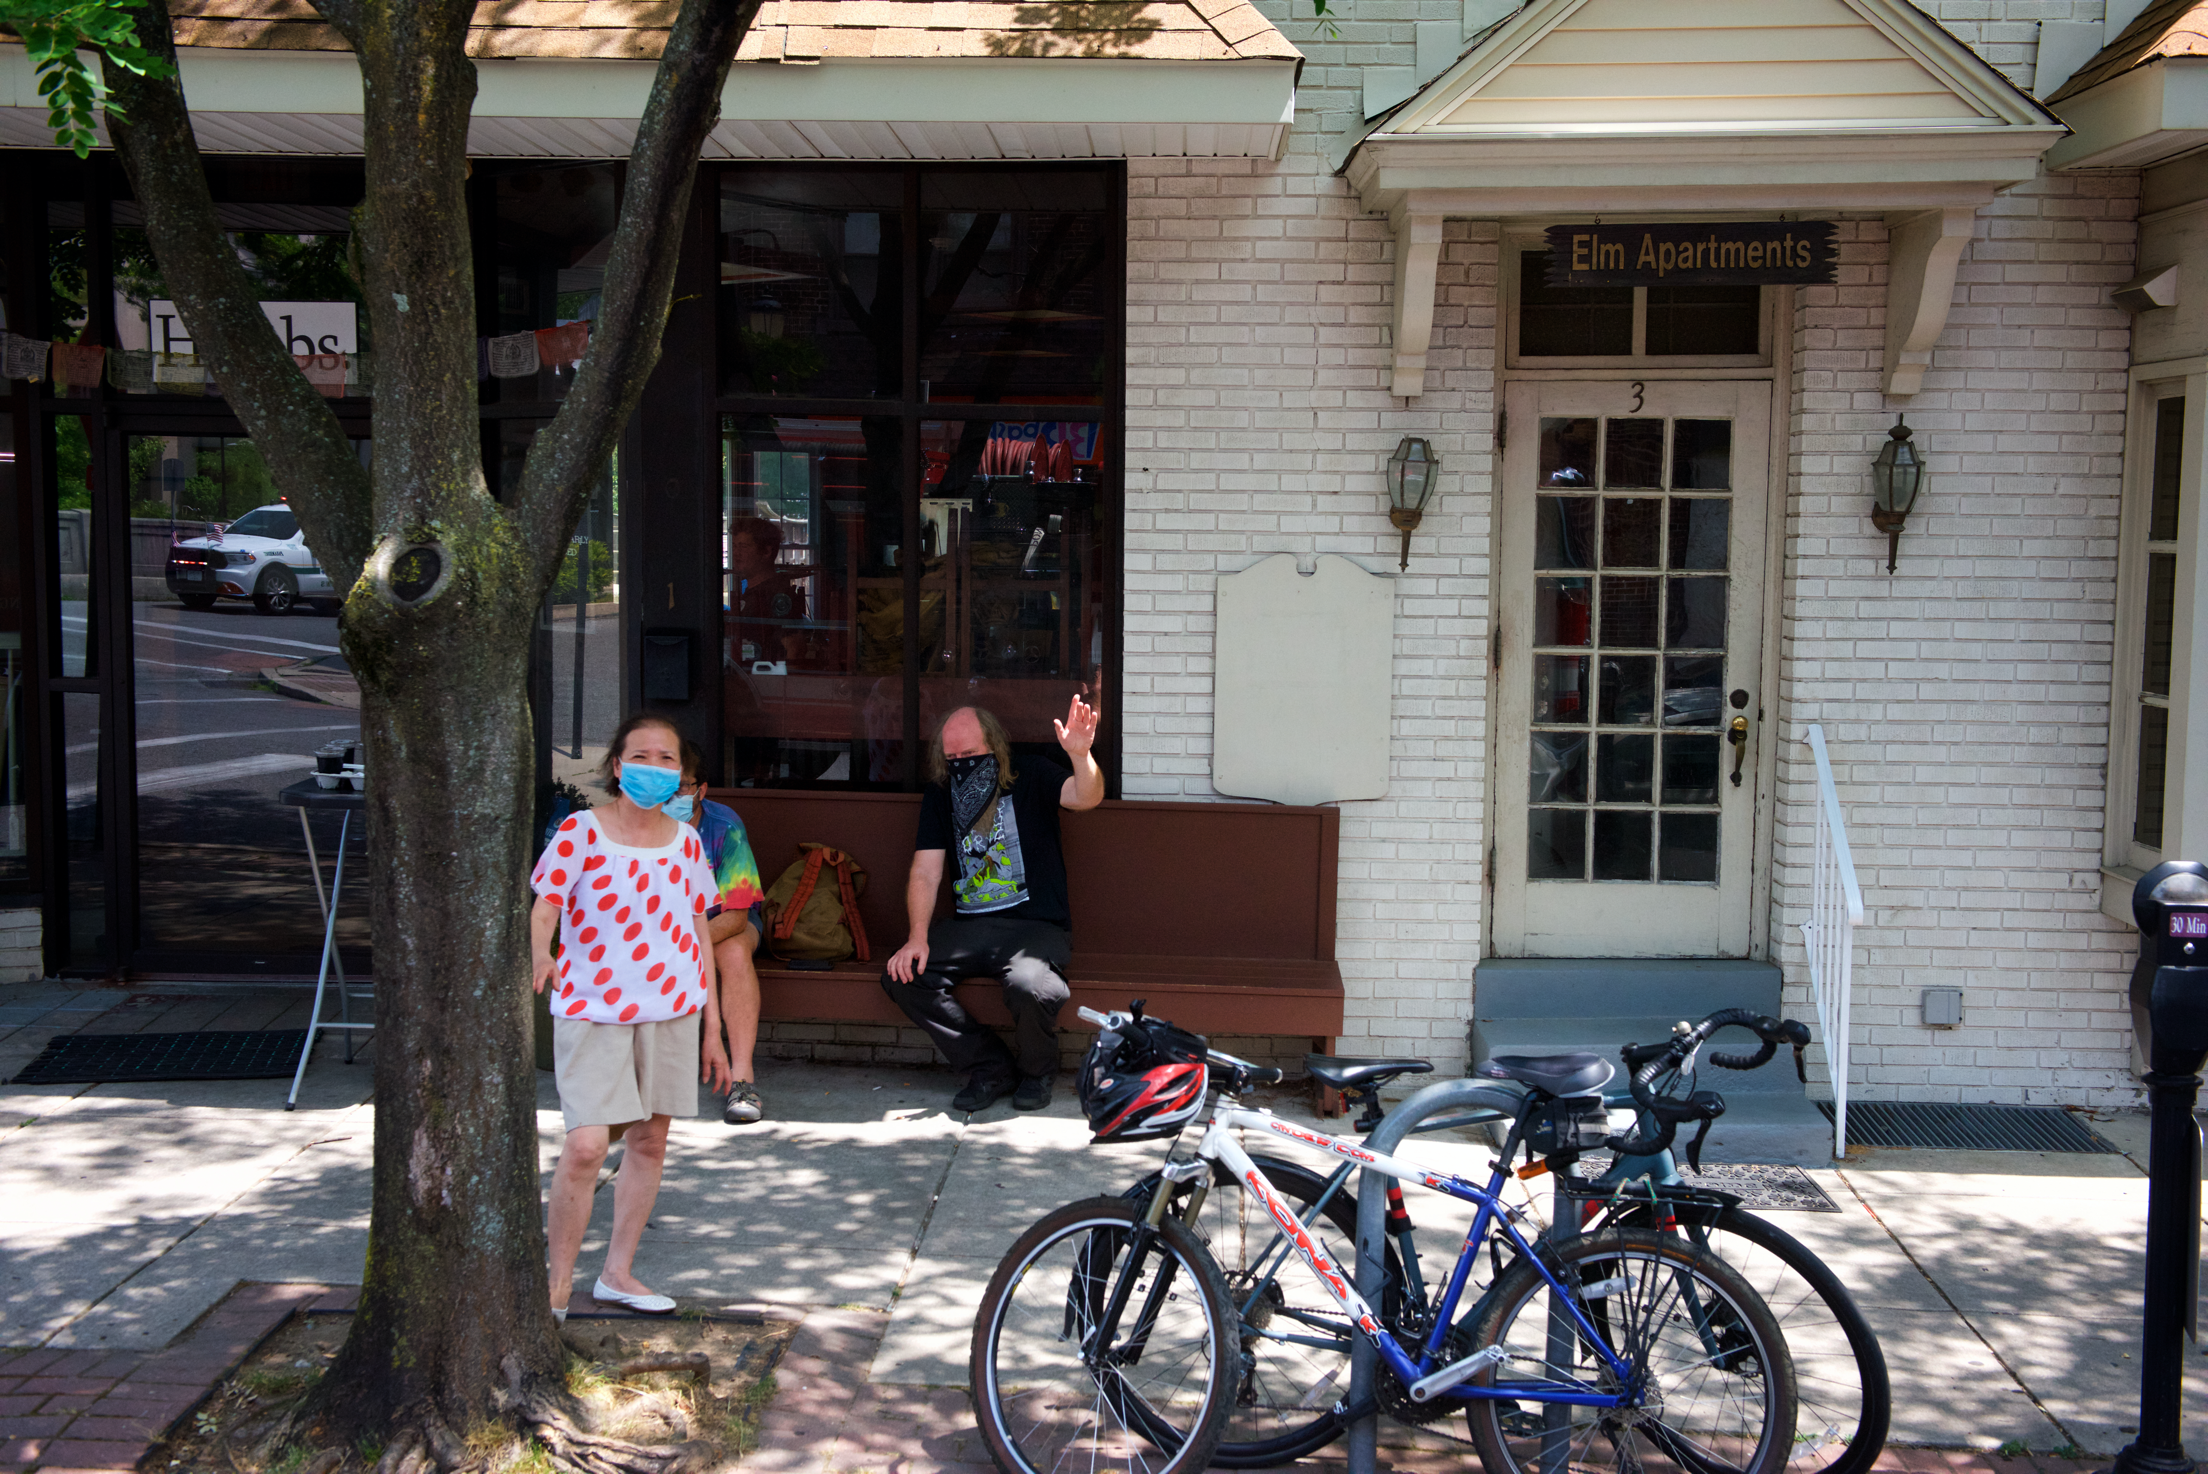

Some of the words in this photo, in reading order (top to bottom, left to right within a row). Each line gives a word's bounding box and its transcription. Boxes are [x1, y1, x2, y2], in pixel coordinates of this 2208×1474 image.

[1572, 234, 1625, 271] Elm
[1636, 233, 1811, 277] Apartments
[1629, 381, 1645, 413] 3
[2171, 916, 2184, 934] 30
[2186, 916, 2207, 934] Min
[1246, 1169, 1350, 1301] KONA
